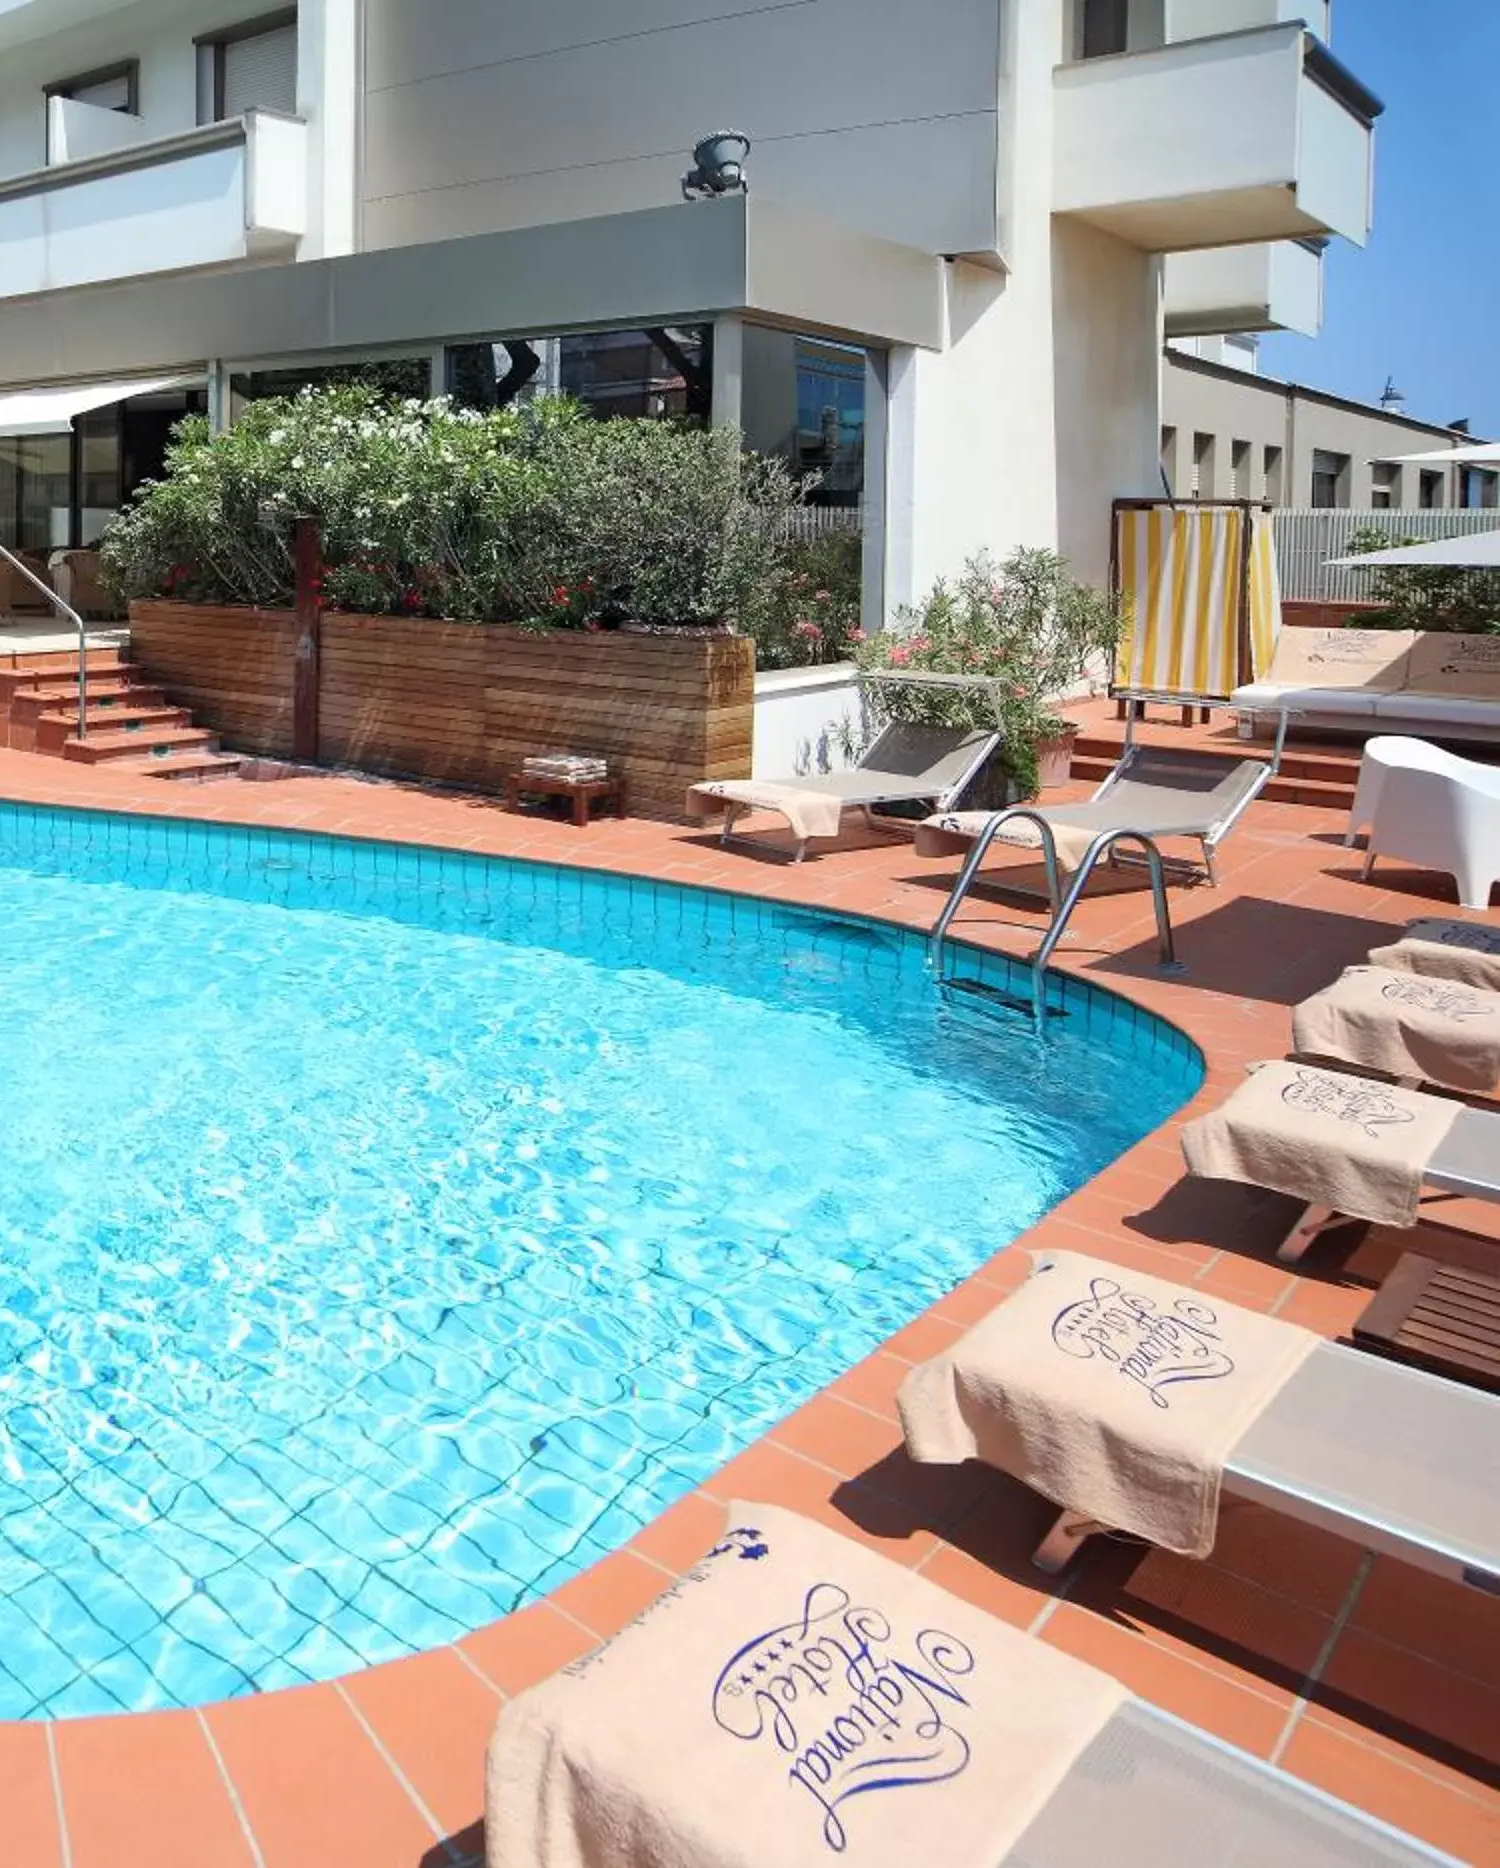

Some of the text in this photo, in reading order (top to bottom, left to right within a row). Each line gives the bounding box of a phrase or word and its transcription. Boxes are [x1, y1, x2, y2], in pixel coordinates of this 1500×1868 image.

[1052, 1277, 1157, 1362] Hotel
[1119, 1299, 1235, 1409] National
[712, 1583, 891, 1752] Hotel
[789, 1629, 974, 1852] National
